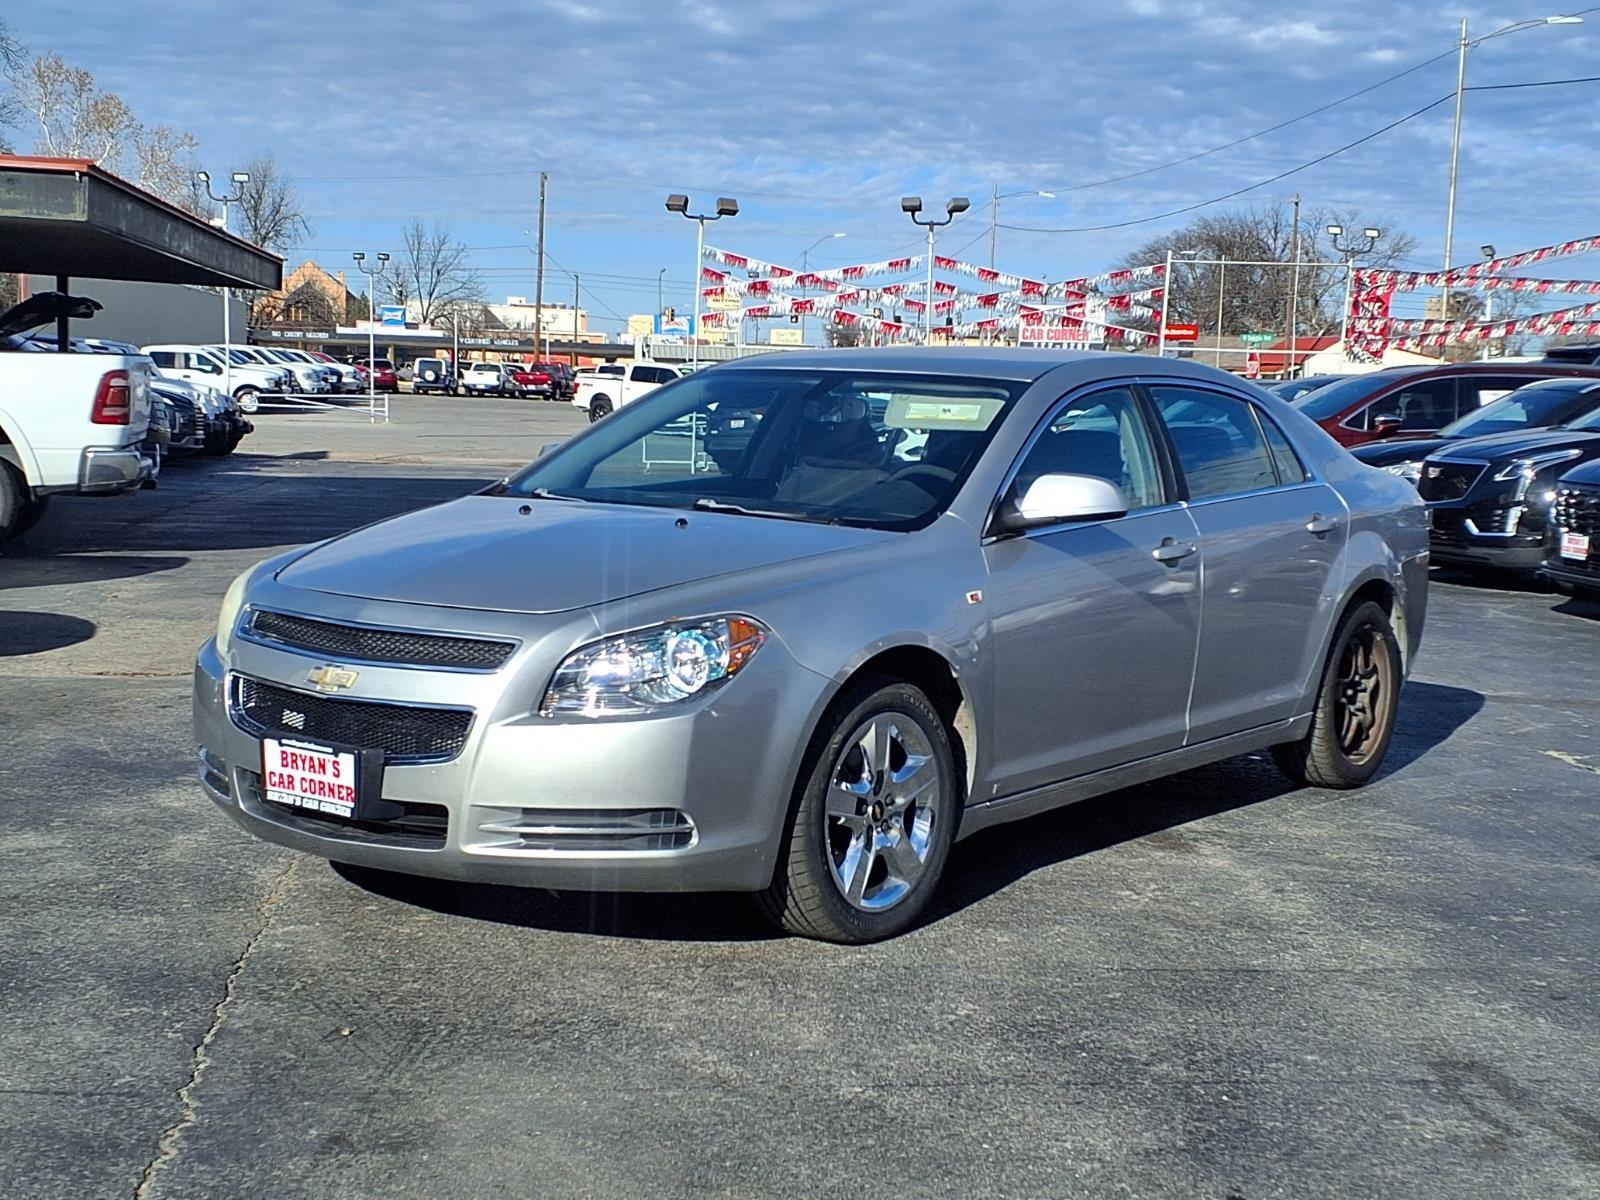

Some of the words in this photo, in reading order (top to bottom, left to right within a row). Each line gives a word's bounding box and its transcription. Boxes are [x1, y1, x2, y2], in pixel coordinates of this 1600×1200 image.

[1022, 328, 1044, 341] CAR
[1046, 328, 1089, 341] CORNER
[280, 750, 340, 778] BRYAN'S
[268, 771, 295, 791] CAR
[299, 777, 356, 803] CORNER
